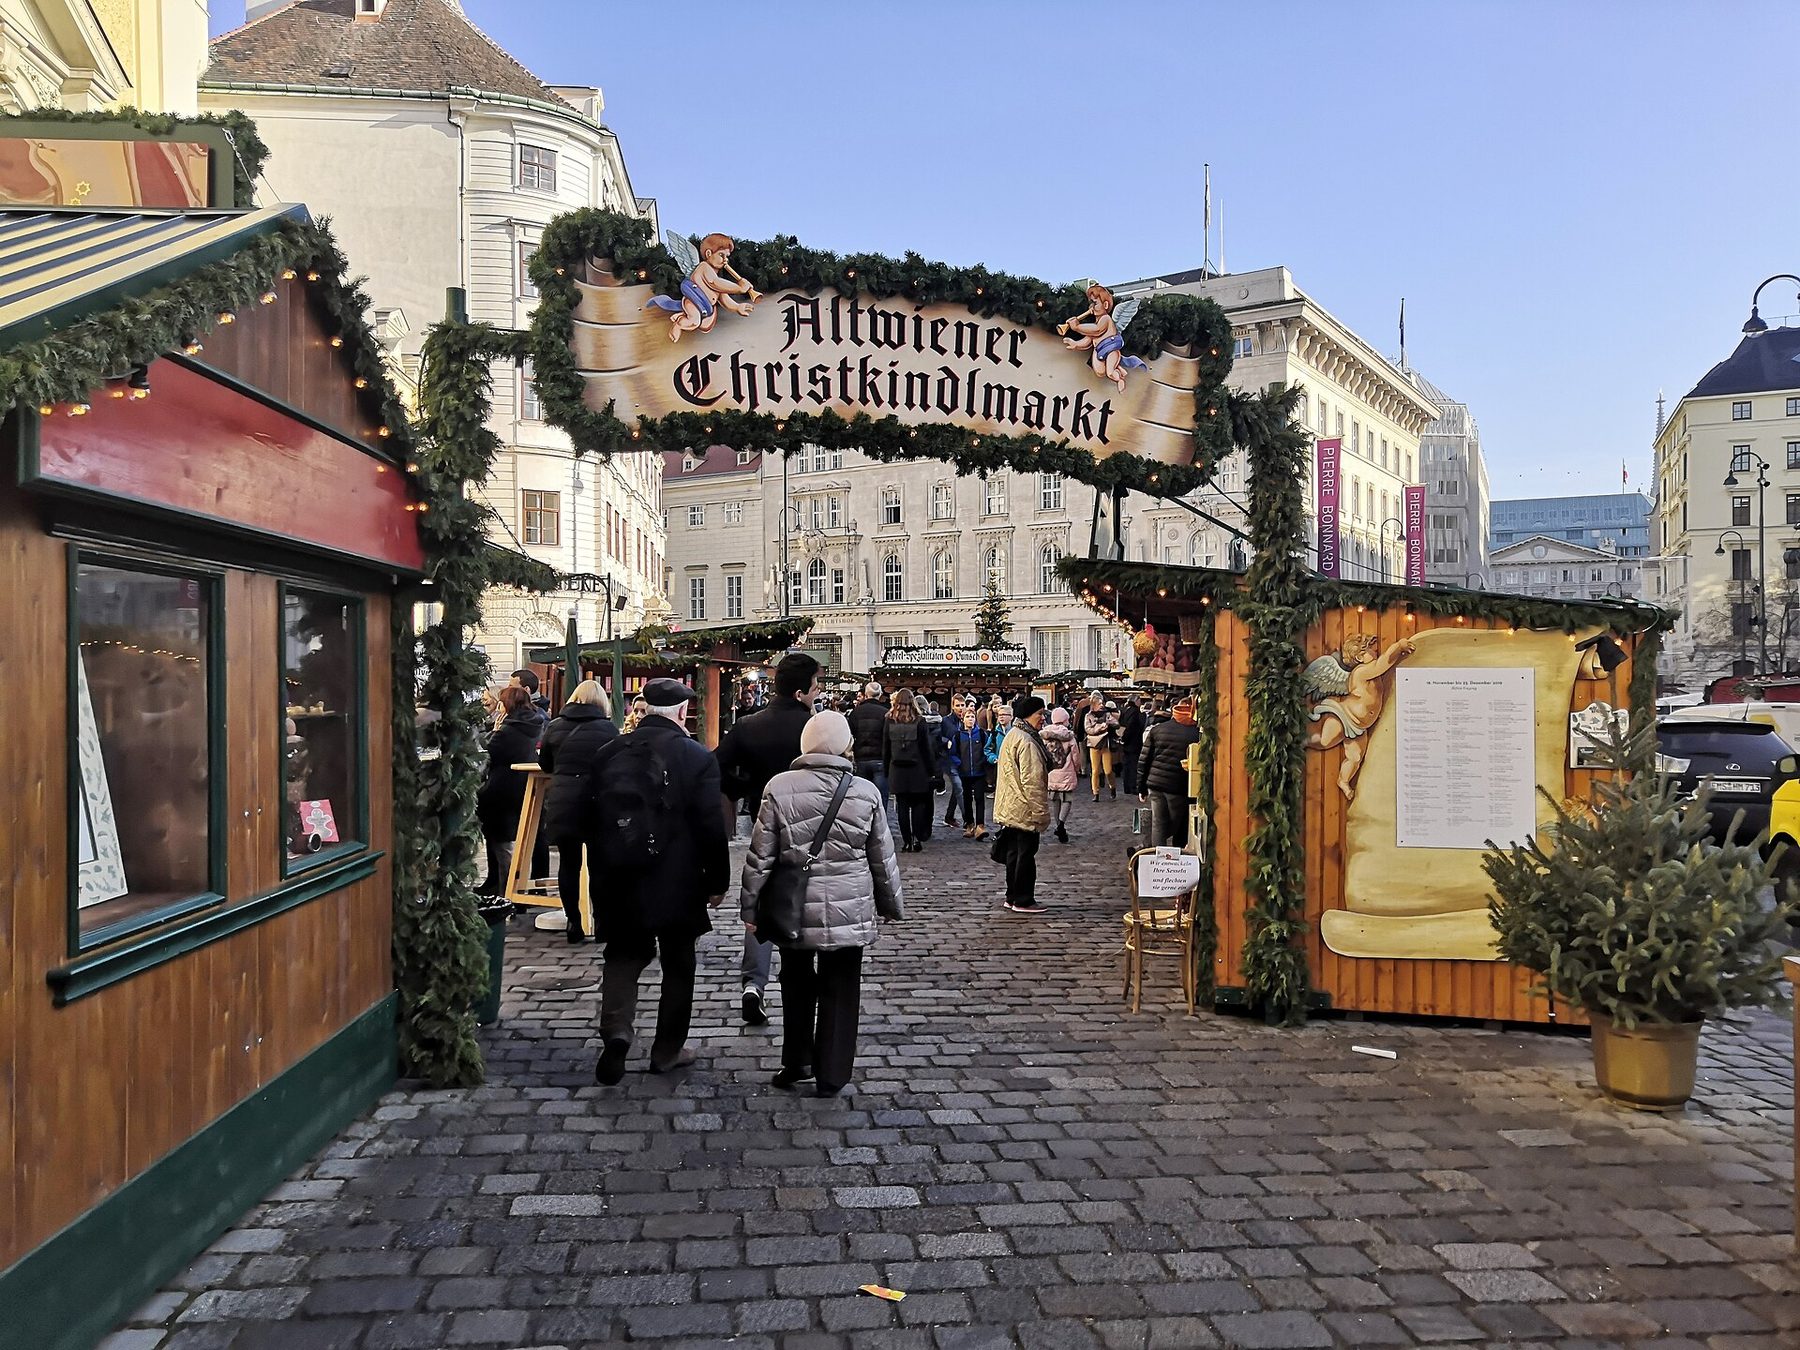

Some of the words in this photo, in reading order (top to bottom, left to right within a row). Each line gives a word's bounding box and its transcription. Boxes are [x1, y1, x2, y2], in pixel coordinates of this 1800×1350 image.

[777, 293, 1027, 368] Altwiener
[673, 350, 1114, 444] Christkindlmarkt
[1322, 447, 1335, 497] PIERRE
[1410, 492, 1421, 532] PIERRE
[1321, 505, 1335, 571] BONNARD
[1410, 539, 1421, 587] BONNAR
[955, 651, 980, 662] Punsch
